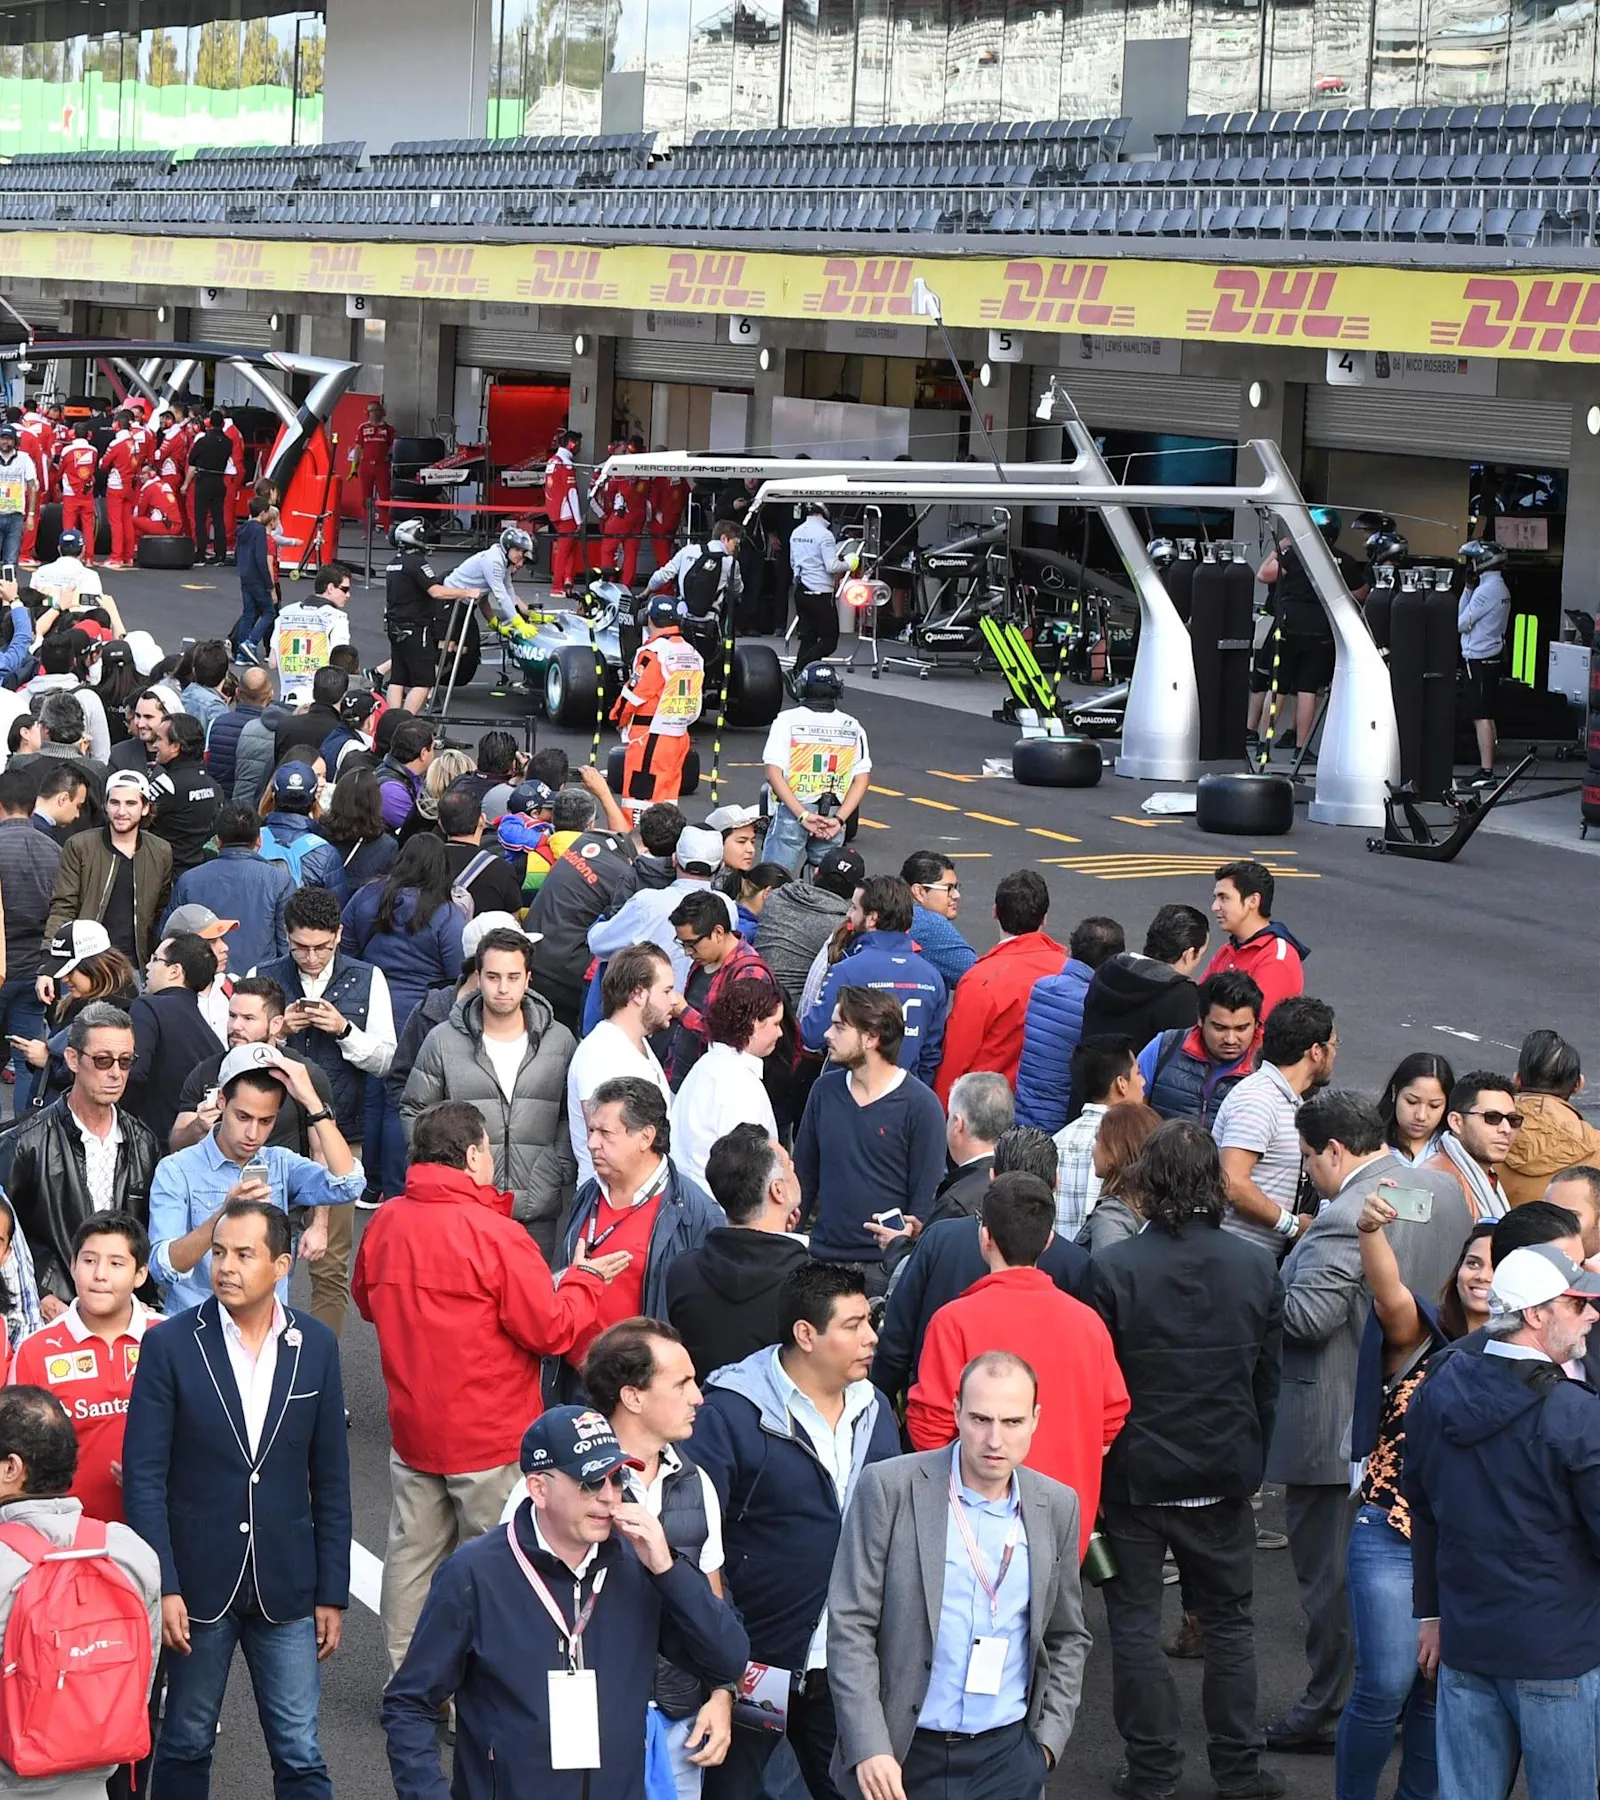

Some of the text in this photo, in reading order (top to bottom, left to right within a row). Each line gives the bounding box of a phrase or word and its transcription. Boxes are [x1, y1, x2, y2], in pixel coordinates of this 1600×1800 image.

[129, 240, 175, 278] DHL
[214, 244, 264, 285] DHL
[307, 246, 366, 289] DHL
[411, 247, 477, 293] DHL
[530, 250, 604, 300] DHL
[664, 253, 750, 307] DHL
[819, 259, 929, 316] DHL
[207, 288, 217, 301] 9
[999, 262, 1114, 326] DHL
[1208, 269, 1345, 337] DHL
[354, 297, 365, 310] 8
[739, 318, 750, 334] 6
[999, 333, 1012, 351] 5
[1104, 342, 1122, 352] LEWIS
[1123, 343, 1151, 355] HAMILTON
[1338, 352, 1353, 373] 4
[1405, 358, 1423, 371] NICO
[1424, 360, 1457, 374] ROSBERG
[929, 558, 968, 569] QUALCOMM
[925, 632, 965, 643] QUALCOMM
[1073, 715, 1117, 727] QUALCOMM
[799, 774, 818, 784] PIT
[838, 860, 852, 873] 87
[867, 981, 894, 989] WILLIAMS
[917, 983, 936, 991] RACING
[77, 1357, 93, 1370] ups
[74, 1399, 130, 1419] Santa
[744, 1667, 763, 1687] 21
